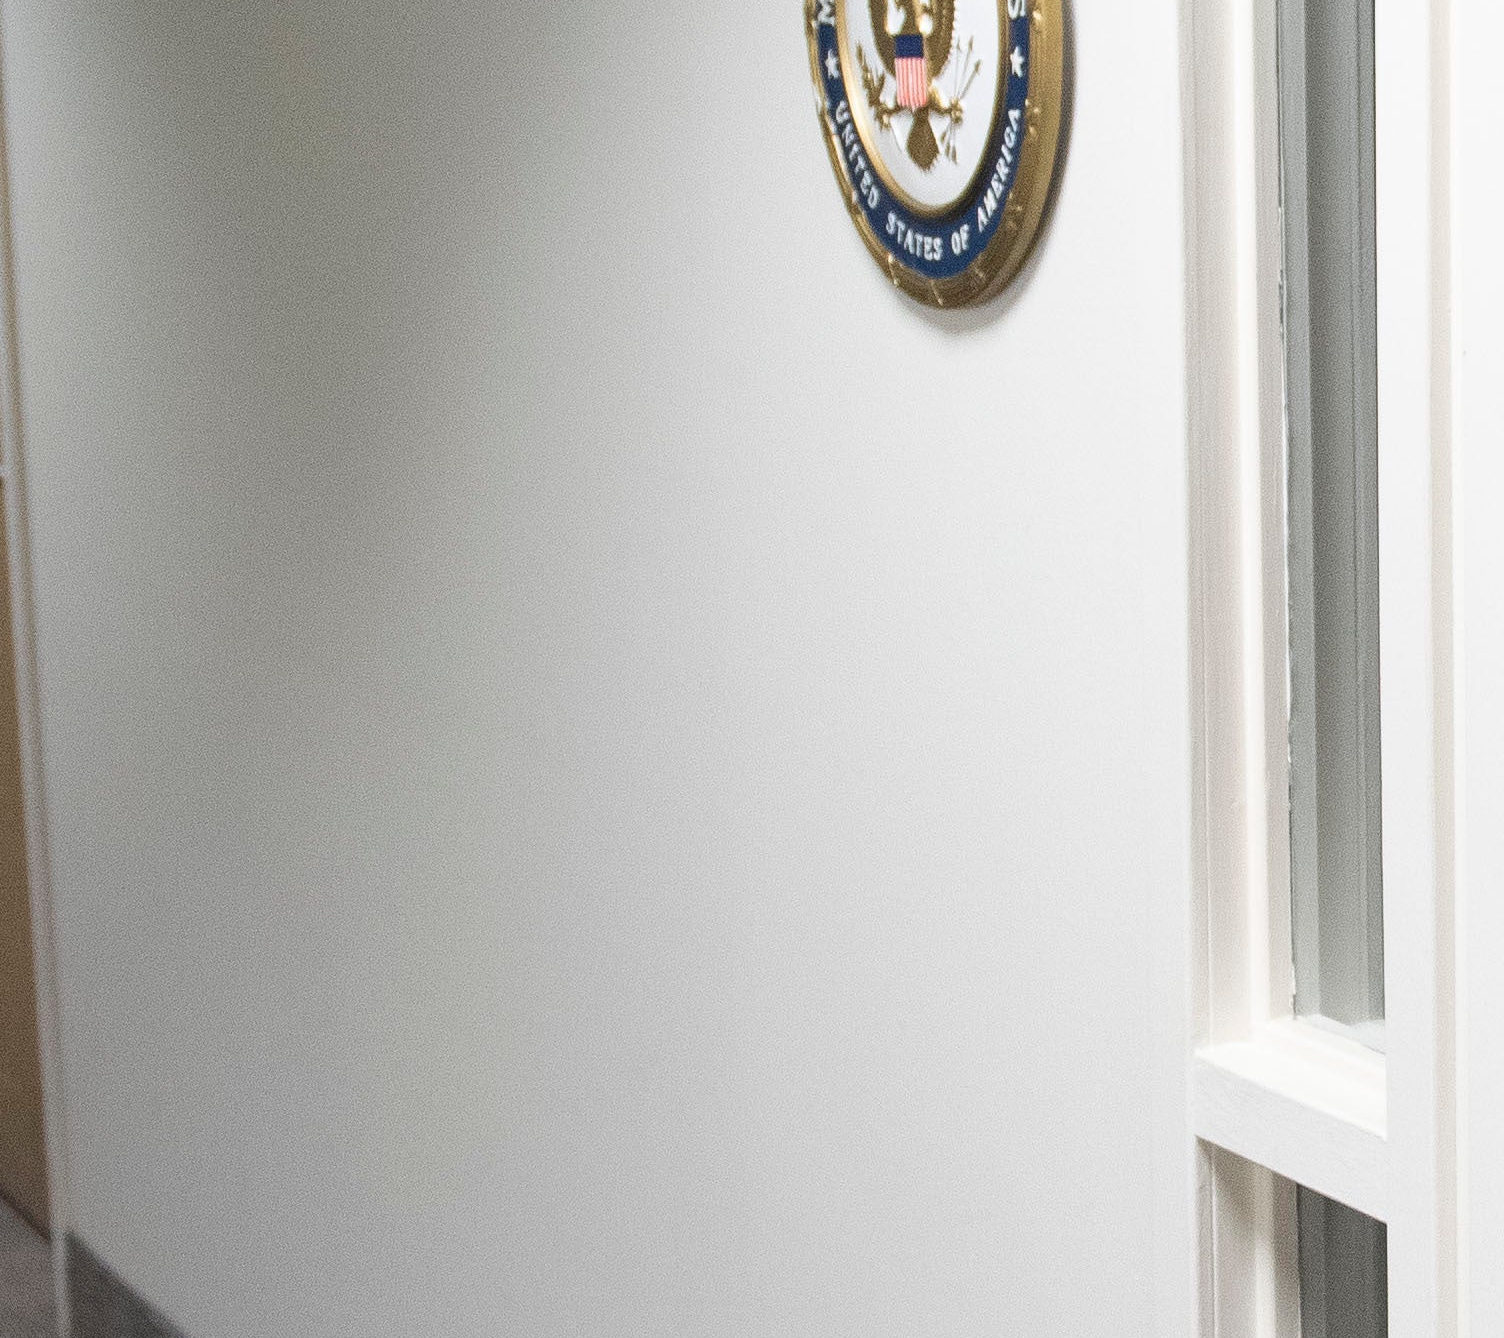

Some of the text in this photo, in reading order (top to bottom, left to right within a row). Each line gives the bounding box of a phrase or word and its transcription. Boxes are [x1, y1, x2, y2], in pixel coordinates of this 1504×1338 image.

[835, 100, 1022, 262] UNITED STATES OF AMERICA
